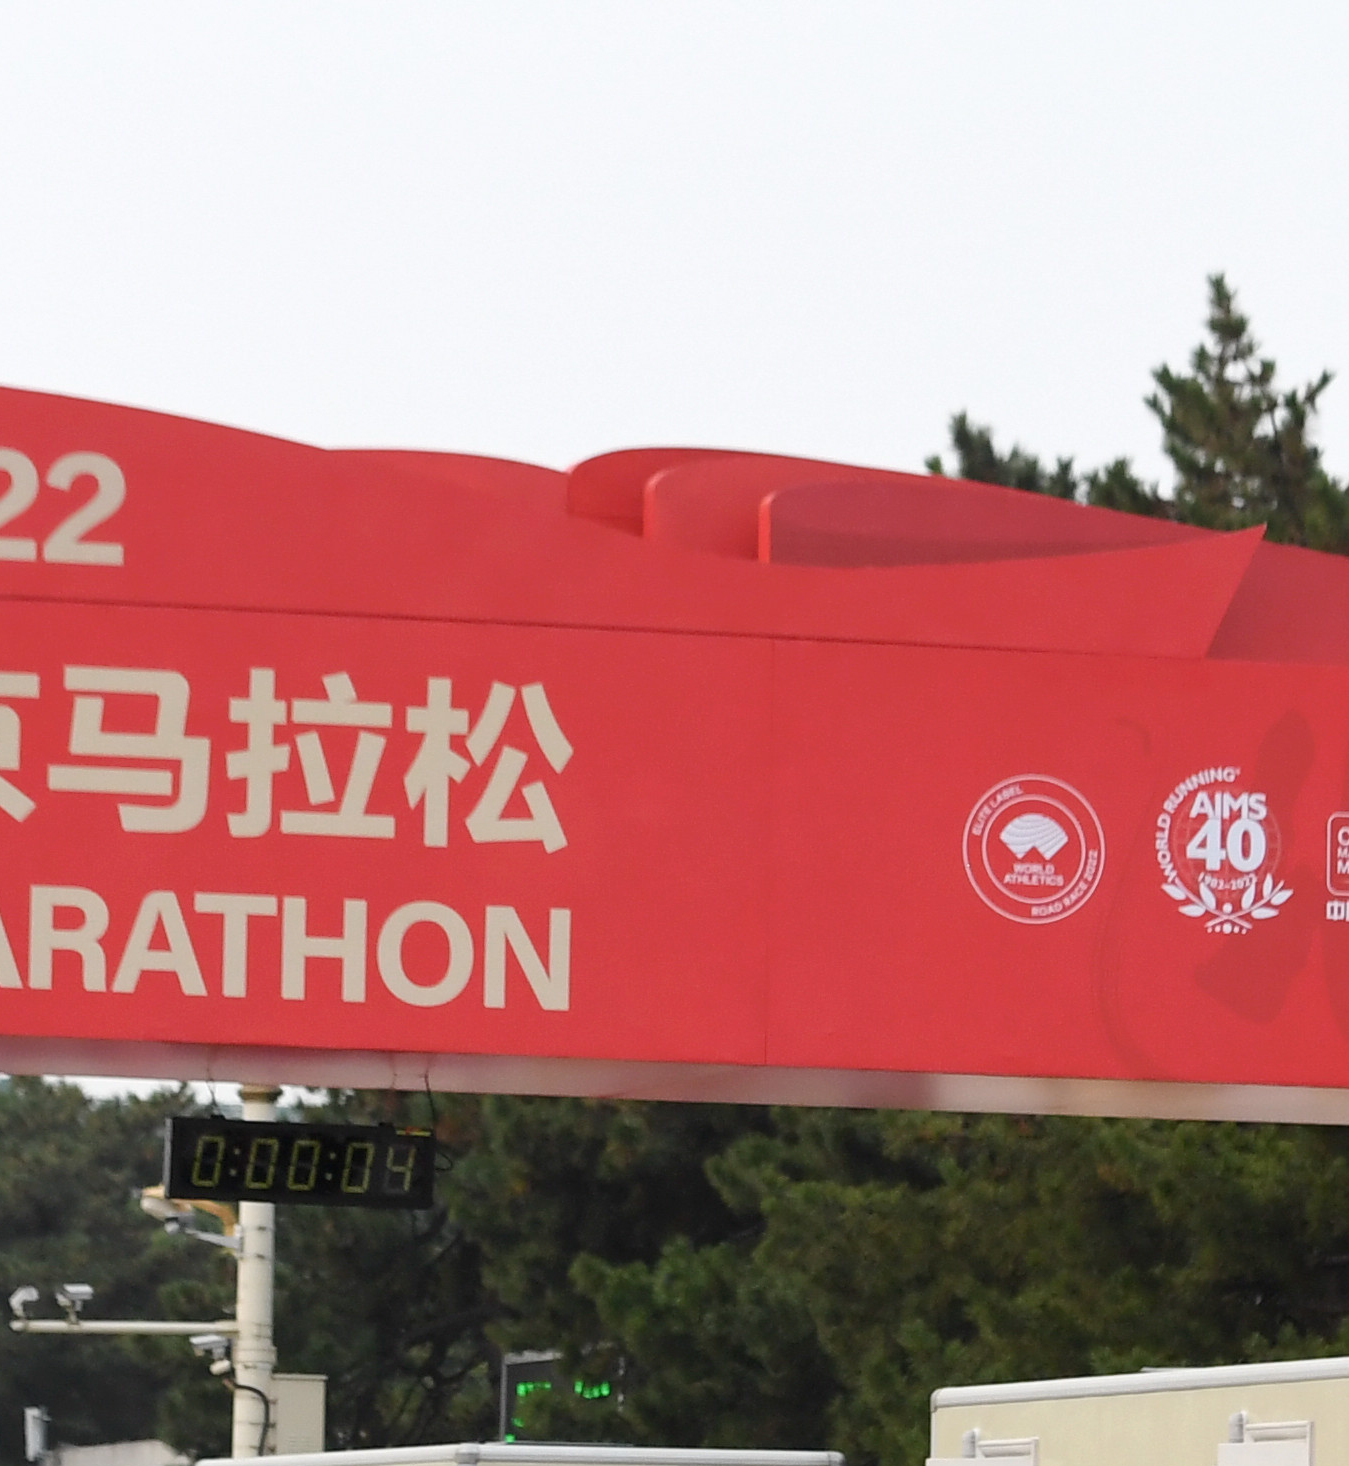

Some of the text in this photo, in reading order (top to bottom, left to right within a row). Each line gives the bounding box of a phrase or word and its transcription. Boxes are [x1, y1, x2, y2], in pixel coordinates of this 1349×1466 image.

[991, 783, 1024, 808] LABEL
[1189, 791, 1267, 821] AIMS
[1155, 813, 1177, 882] WORLD
[1186, 818, 1266, 872] 40
[1004, 873, 1064, 886] ATHLETICS
[1013, 863, 1055, 874] WORLD
[1031, 904, 1063, 916] ROAD
[191, 1135, 417, 1194] 0:00:04
